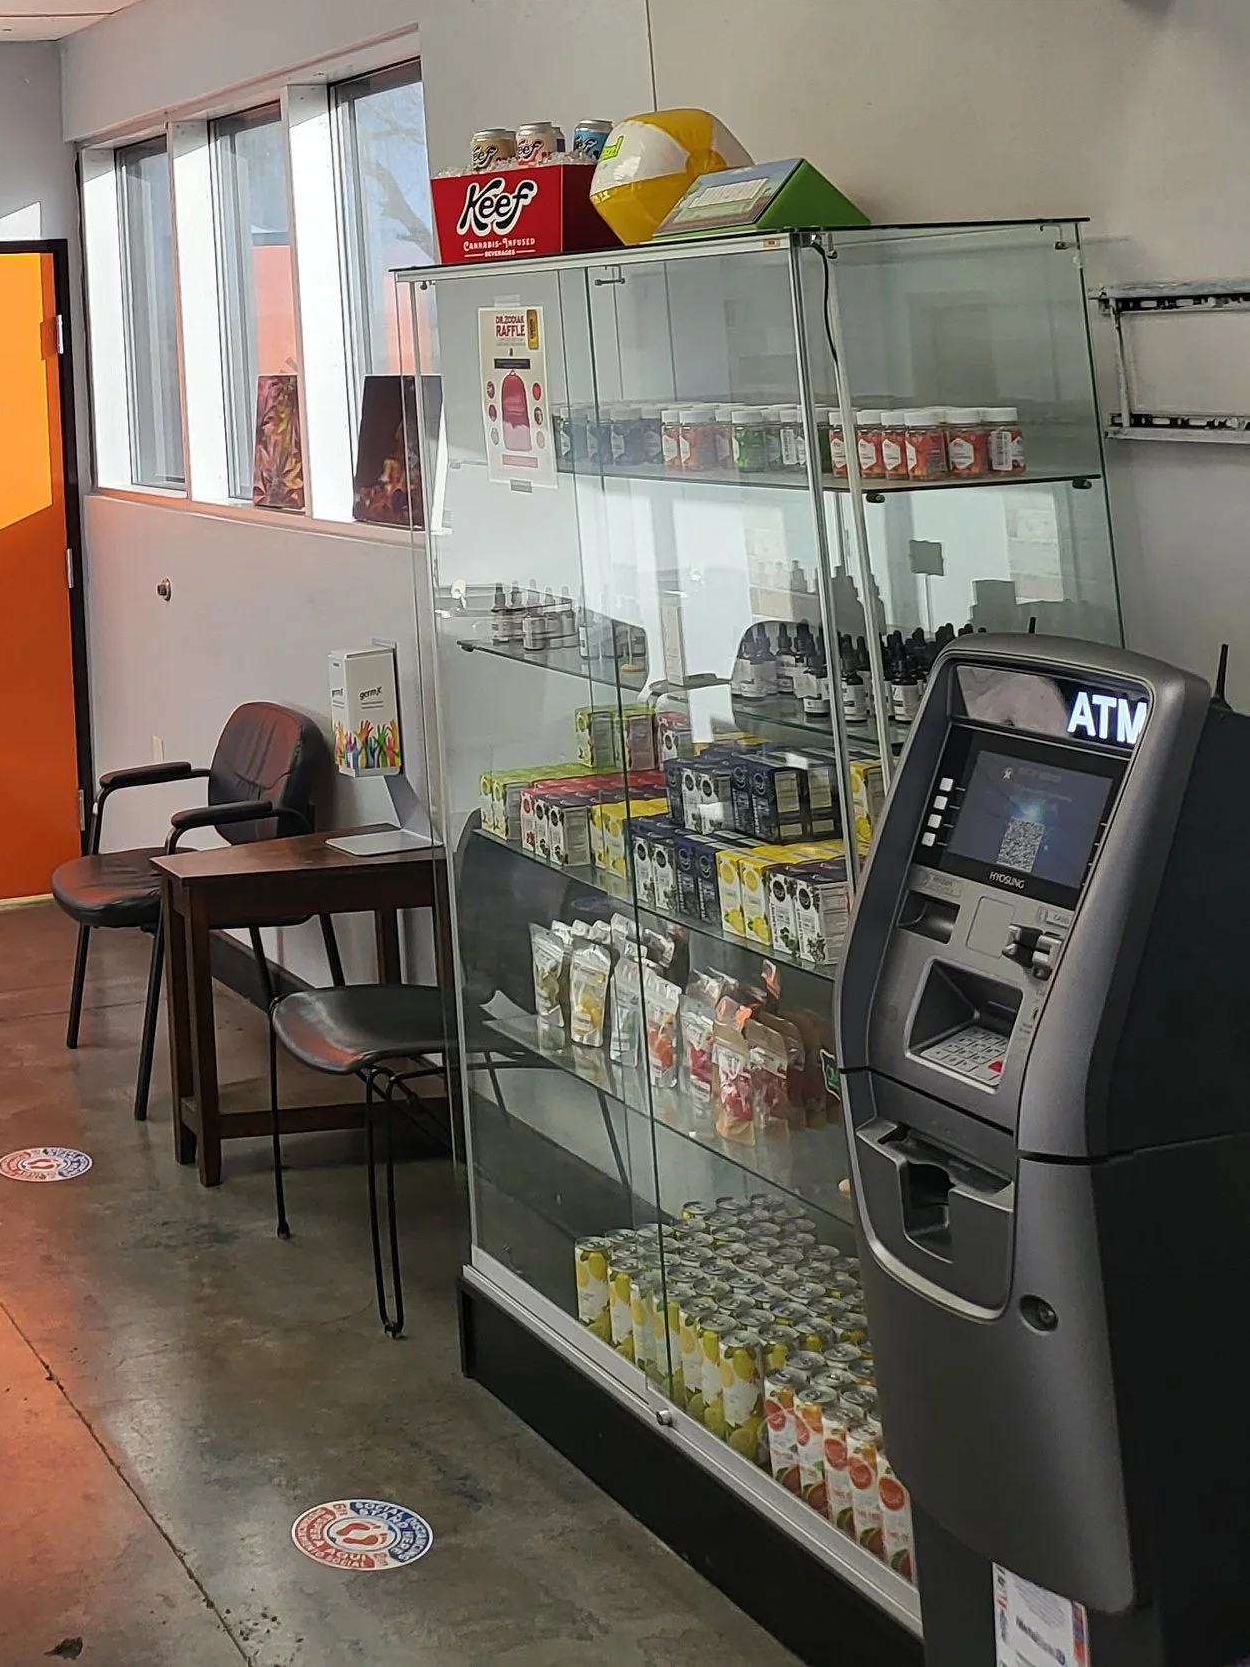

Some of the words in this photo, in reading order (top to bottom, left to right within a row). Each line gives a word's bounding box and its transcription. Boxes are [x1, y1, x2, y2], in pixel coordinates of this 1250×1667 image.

[458, 179, 537, 235] Keef
[495, 325, 526, 337] RAFFLE
[1067, 691, 1147, 744] ATM
[989, 871, 1026, 889] HYOSUNG
[355, 1502, 403, 1518] SOCIAL
[359, 1508, 409, 1529] STAND
